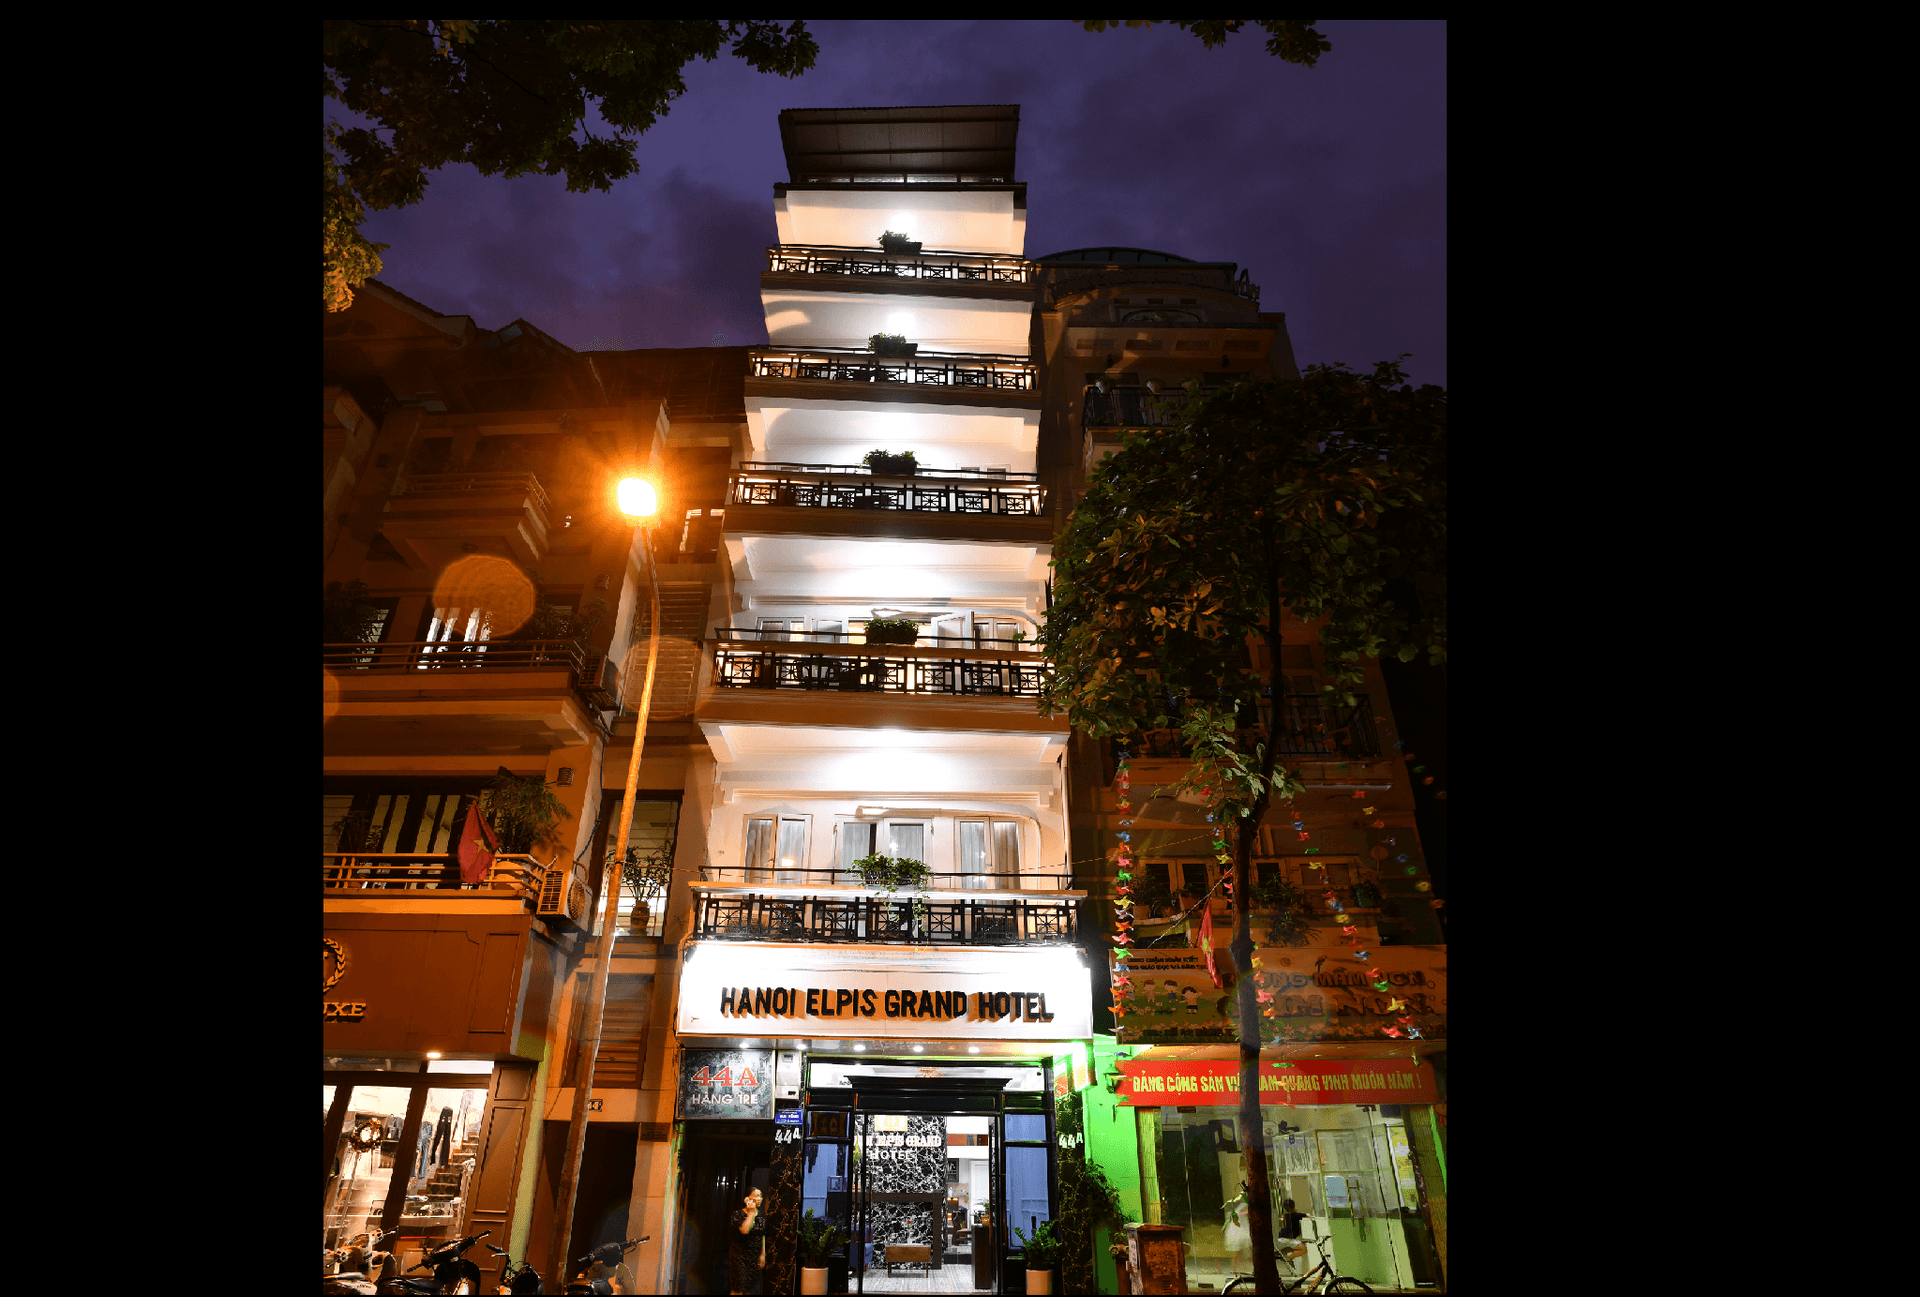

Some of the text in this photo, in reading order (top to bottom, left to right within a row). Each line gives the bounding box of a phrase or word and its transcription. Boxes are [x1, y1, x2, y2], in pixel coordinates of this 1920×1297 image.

[720, 987, 1055, 1020] HANOI ELPIS GRAND HOTEL
[691, 1065, 760, 1087] 44A
[1133, 1070, 1165, 1093] ĐẢNG
[1166, 1072, 1199, 1096] CỘNG
[1200, 1070, 1225, 1093] SẢN
[1322, 1074, 1349, 1091] VINH
[1350, 1070, 1386, 1091] MUÔN
[738, 1094, 759, 1105] TRE
[775, 1127, 801, 1144] 44A
[1059, 1132, 1084, 1149] 44A
[870, 1150, 913, 1160] HOTEL
